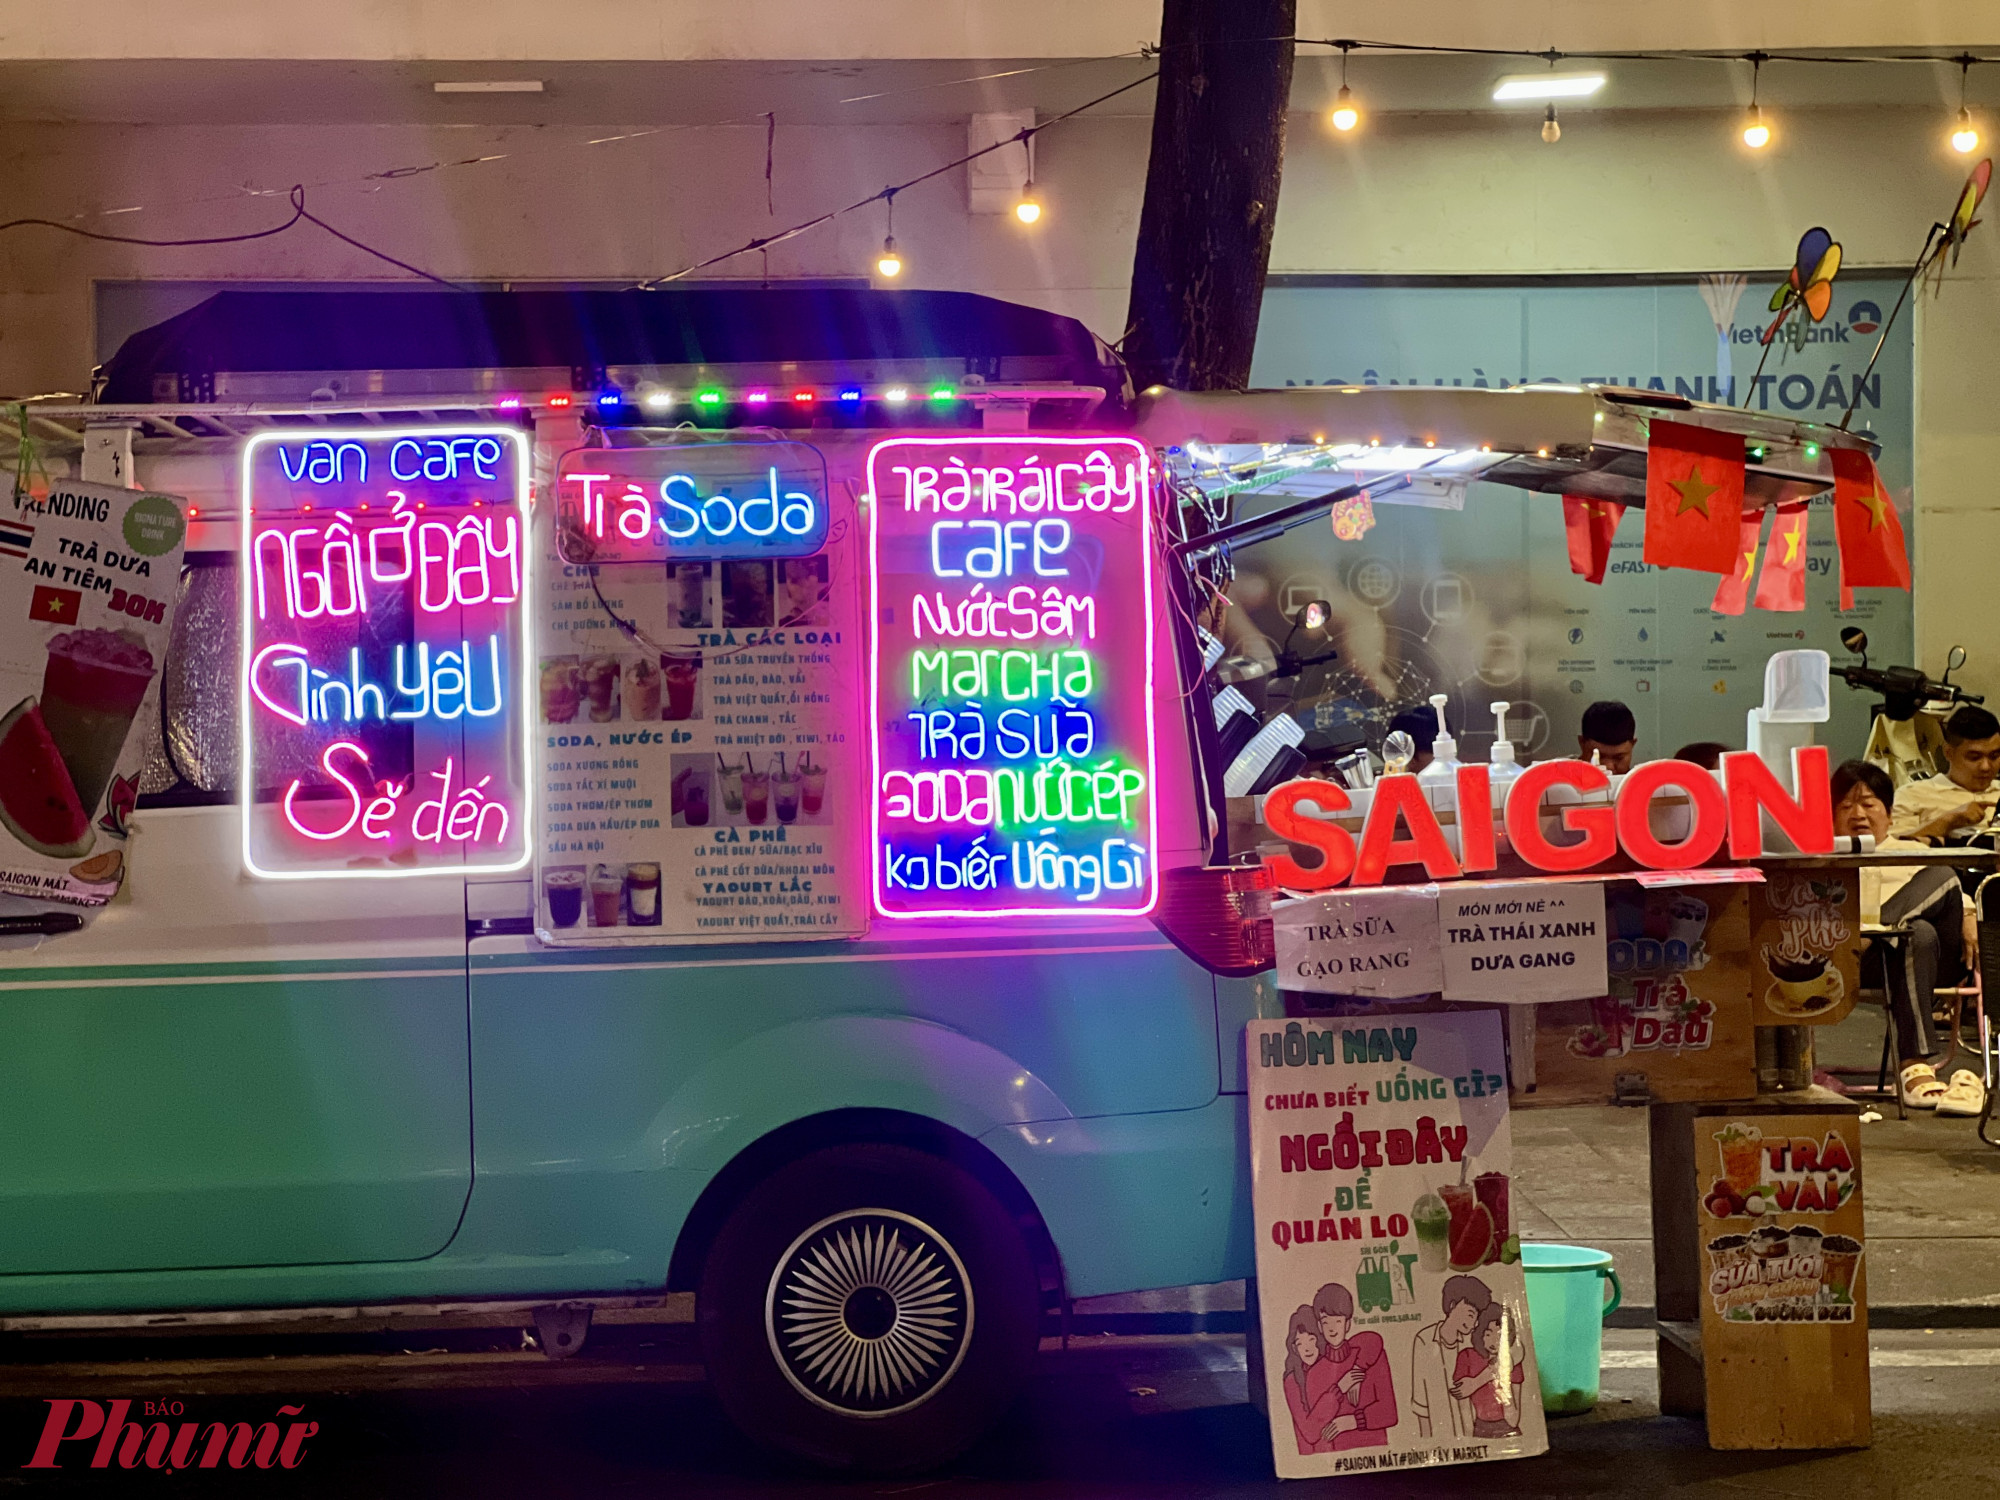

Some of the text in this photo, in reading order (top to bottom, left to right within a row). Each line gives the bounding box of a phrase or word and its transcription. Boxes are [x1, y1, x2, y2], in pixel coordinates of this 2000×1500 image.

[1751, 364, 1881, 410] TOÁN
[658, 466, 815, 538] Soda
[59, 538, 150, 577] TRÀ DƯA
[1806, 556, 1831, 576] ay
[24, 558, 112, 594] AN TIÊM
[698, 629, 841, 648] TRÀ CÁC LOẠI
[713, 674, 732, 685] TRÀ
[714, 694, 732, 705] TRÀ
[714, 714, 733, 725] TRÀ
[610, 729, 663, 745] NƯỚC
[671, 728, 693, 743] ÉP
[714, 733, 733, 745] TRÀ
[547, 760, 572, 771] SODA
[284, 743, 508, 843] Sẽ đến
[547, 780, 572, 792] SODA
[547, 802, 573, 812] SODA
[1262, 746, 1835, 891] SAIGON
[548, 822, 573, 832] SODA
[714, 825, 787, 843] CÀ PHÊ
[0, 871, 40, 887] SAIGON
[703, 876, 813, 894] YAOURT LẮC
[1458, 899, 1546, 917] MÓN MỚI NÈ
[1304, 916, 1396, 941] TRÀ SỮA
[1448, 921, 1597, 944] TRÀ THÁI XANH
[1297, 952, 1410, 979] GẠO RANG
[1471, 951, 1576, 972] DƯA GANG
[1607, 939, 1689, 971] ODA
[1260, 1021, 1417, 1068] HÔM NAY
[1264, 1066, 1502, 1111] CHƯA BIẾT UỐNG GÌ?
[1279, 1111, 1468, 1173] NGỒI ĐÂY
[1762, 1130, 1853, 1172] TRÀ
[1334, 1167, 1373, 1212] ĐỂ
[1774, 1173, 1840, 1211] VẢI
[1271, 1203, 1409, 1251] QUÁN LO
[1335, 1456, 1376, 1472] #SAIGON
[1453, 1445, 1488, 1461] MARKET
